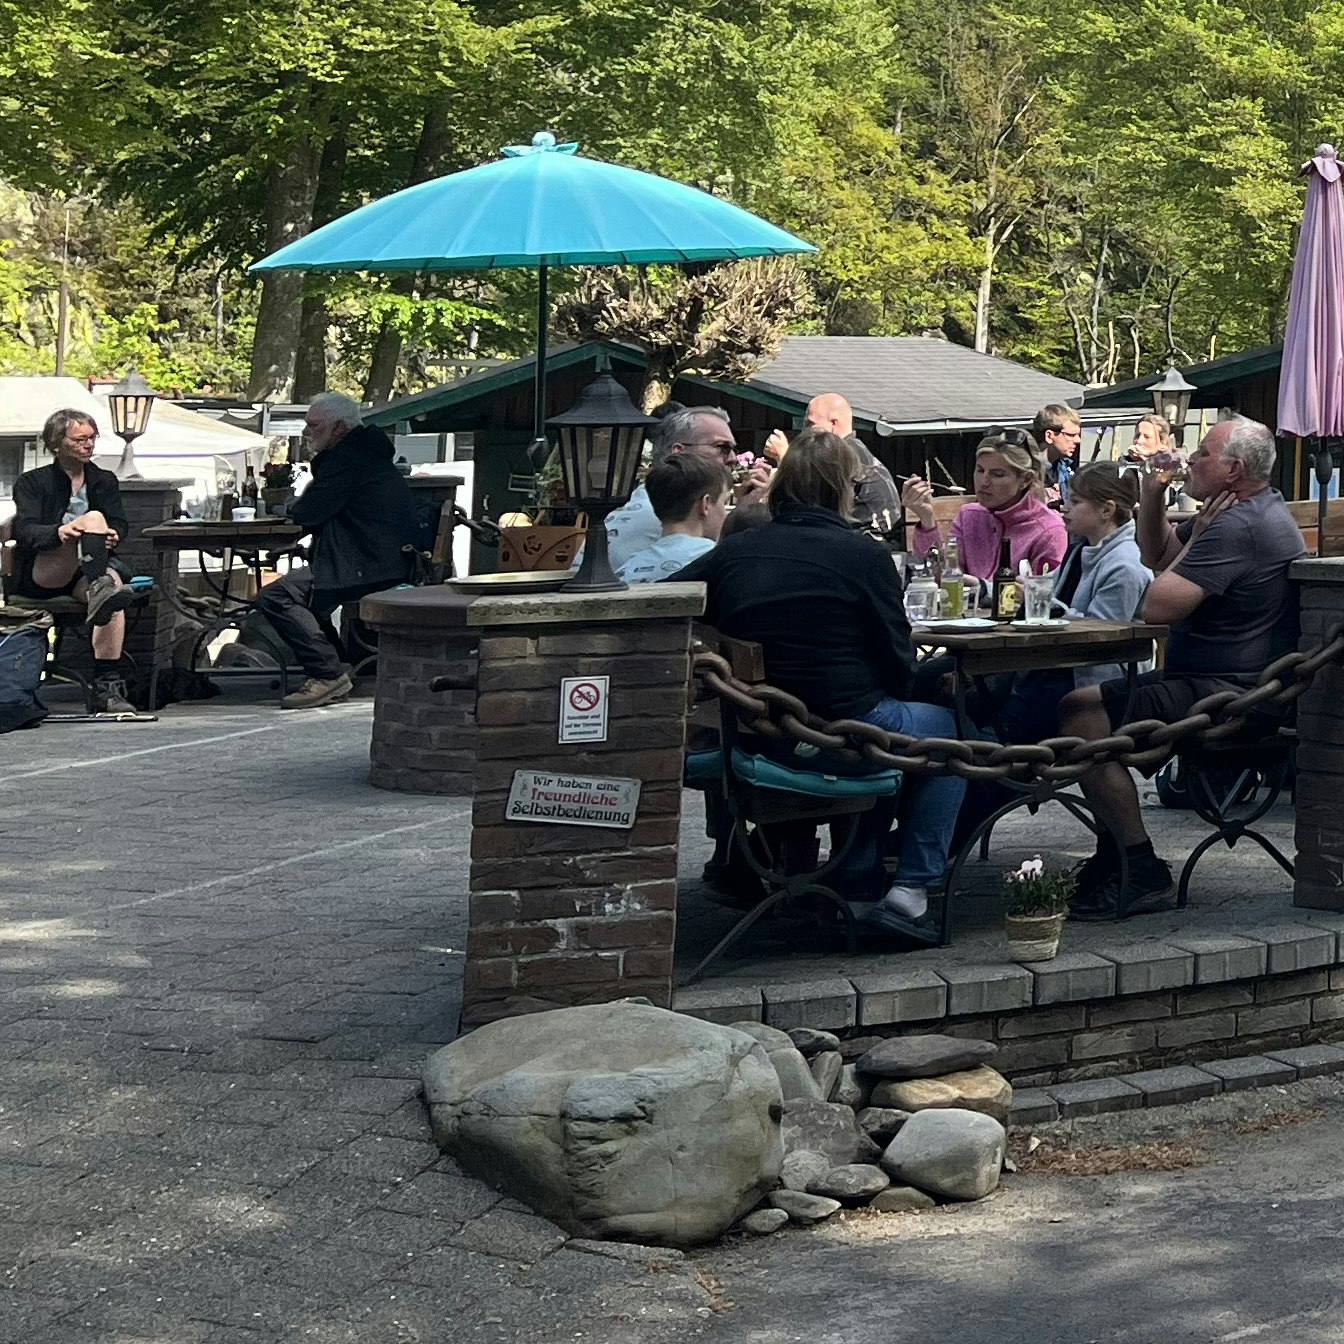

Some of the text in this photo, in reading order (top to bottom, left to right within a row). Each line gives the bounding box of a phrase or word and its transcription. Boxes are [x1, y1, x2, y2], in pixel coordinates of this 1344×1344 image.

[533, 775, 621, 792] Wir haben eine
[530, 787, 618, 806] freundliche
[511, 800, 631, 825] Selbstbedienung
